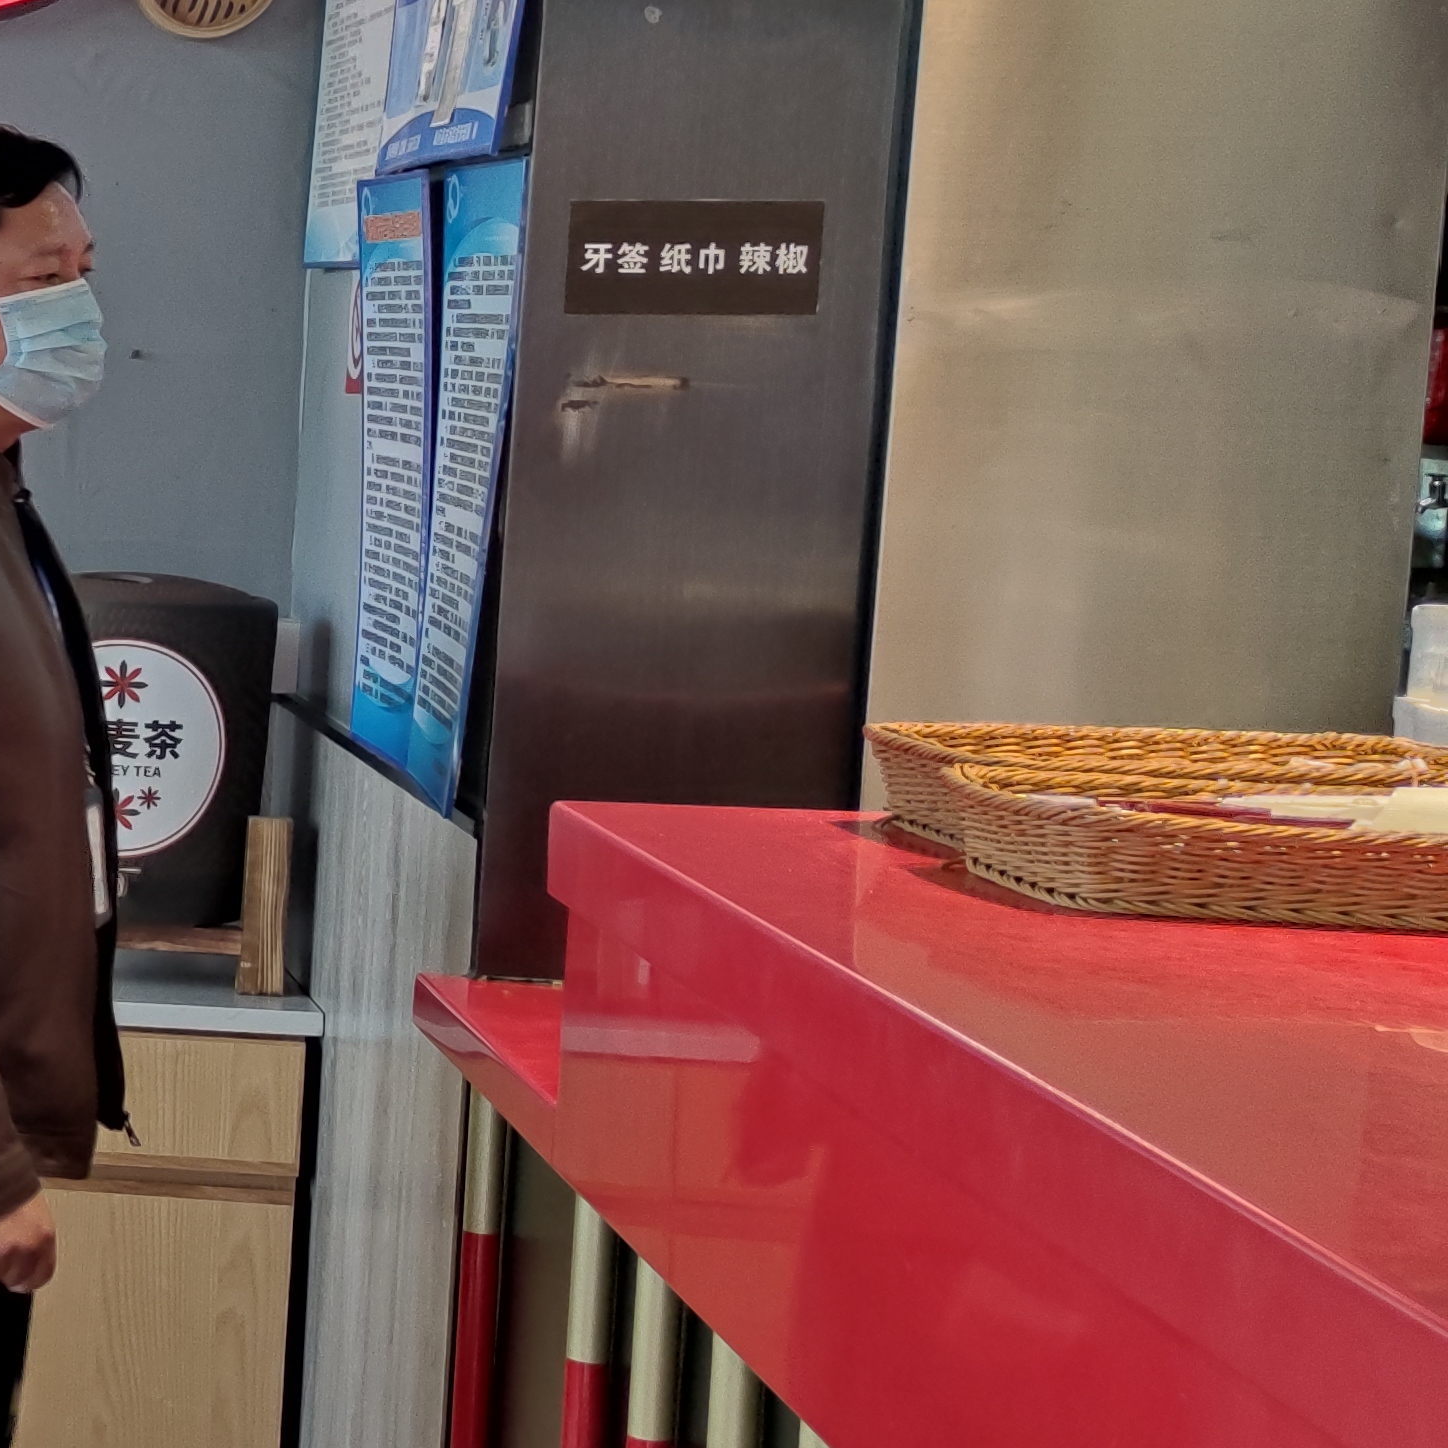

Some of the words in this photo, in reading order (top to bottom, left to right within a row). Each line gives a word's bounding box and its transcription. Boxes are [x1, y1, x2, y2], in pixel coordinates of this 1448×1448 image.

[580, 242, 649, 274] 牙签
[659, 242, 725, 274] 纸巾
[739, 242, 809, 274] 辣椒
[106, 718, 184, 760] 麦茶
[133, 764, 161, 778] TEA
